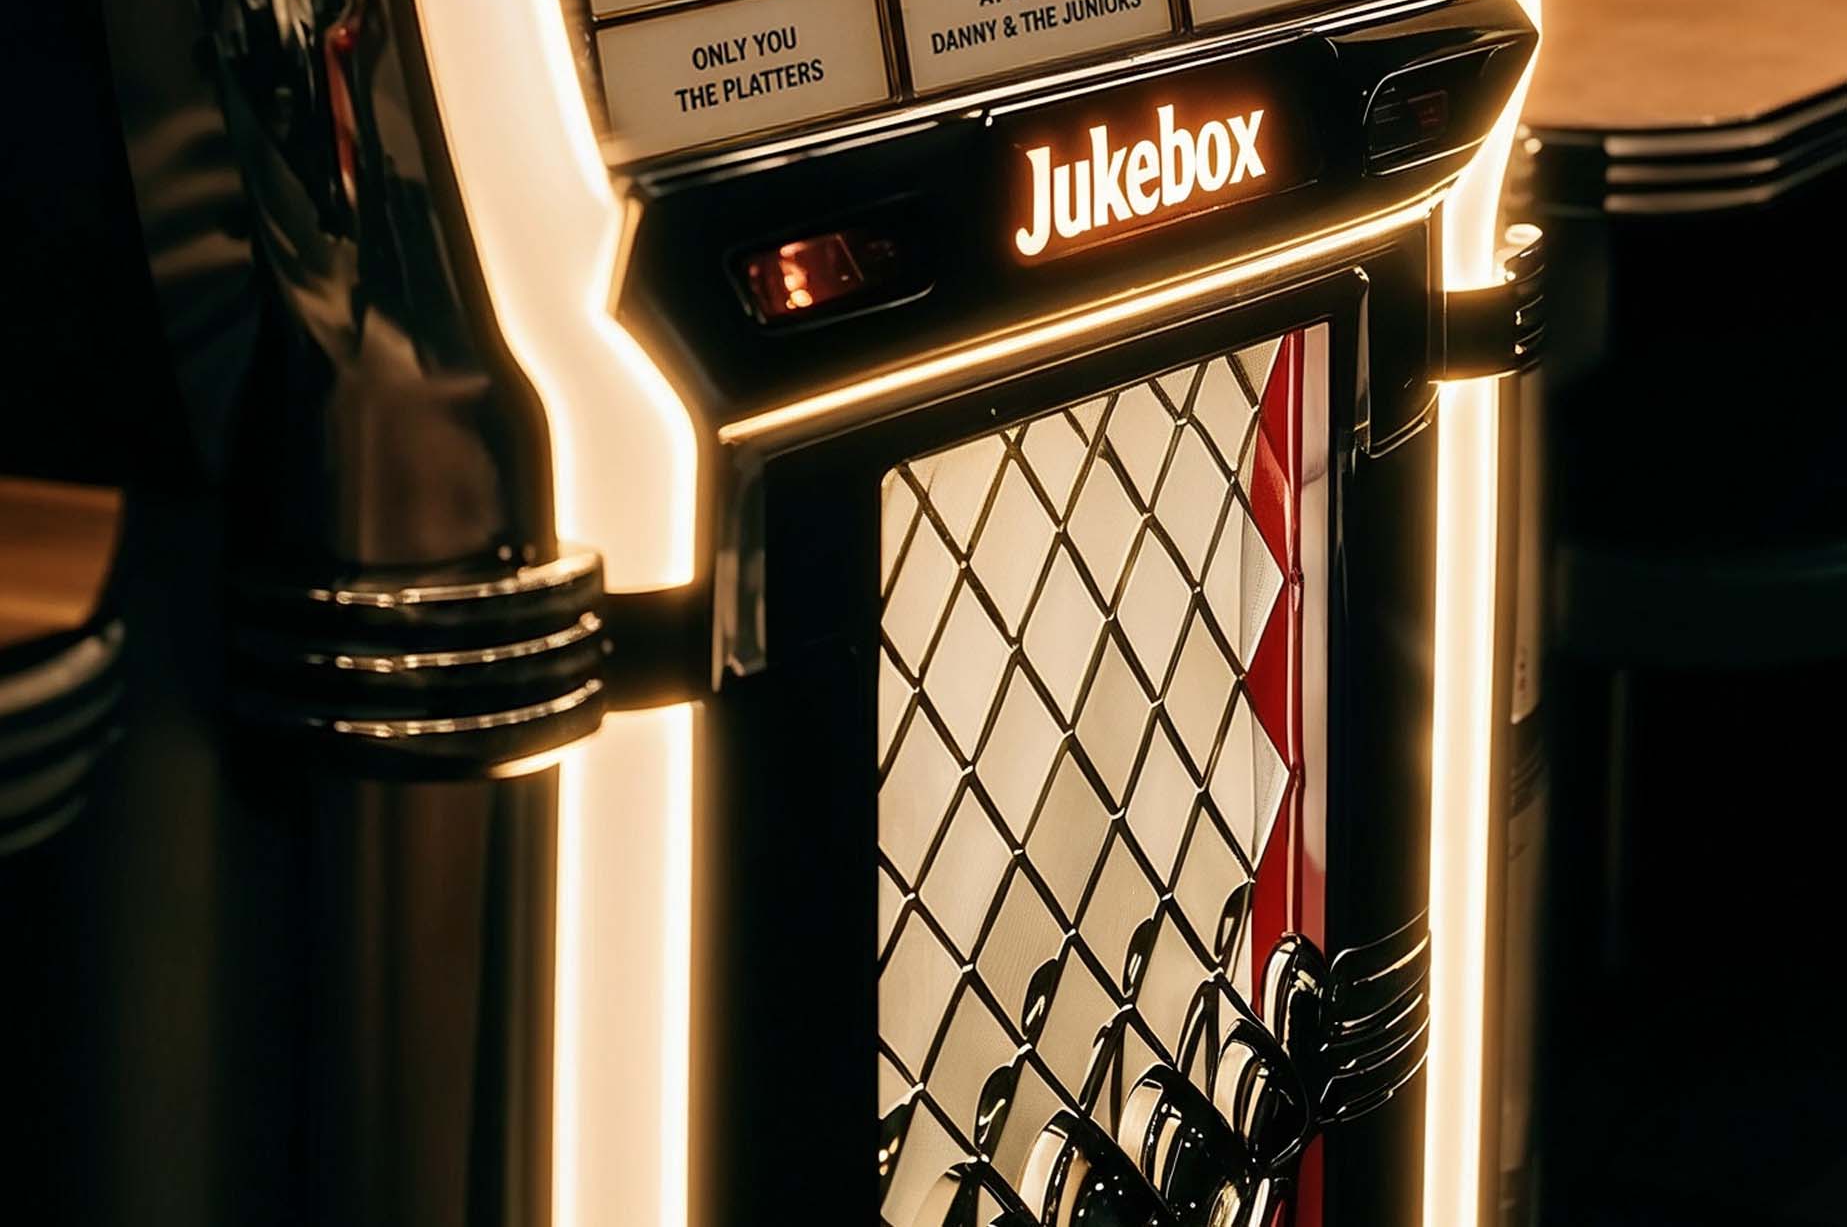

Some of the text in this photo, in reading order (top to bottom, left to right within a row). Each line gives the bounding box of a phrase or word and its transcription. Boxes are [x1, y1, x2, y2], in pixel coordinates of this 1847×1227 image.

[691, 26, 797, 71] ONLY YOU
[931, 18, 997, 55] DANNY
[1002, 15, 1019, 39] &
[1019, 5, 1059, 33] THE
[674, 58, 824, 113] THE PLATTERS
[1013, 104, 1267, 258] Jukebox
